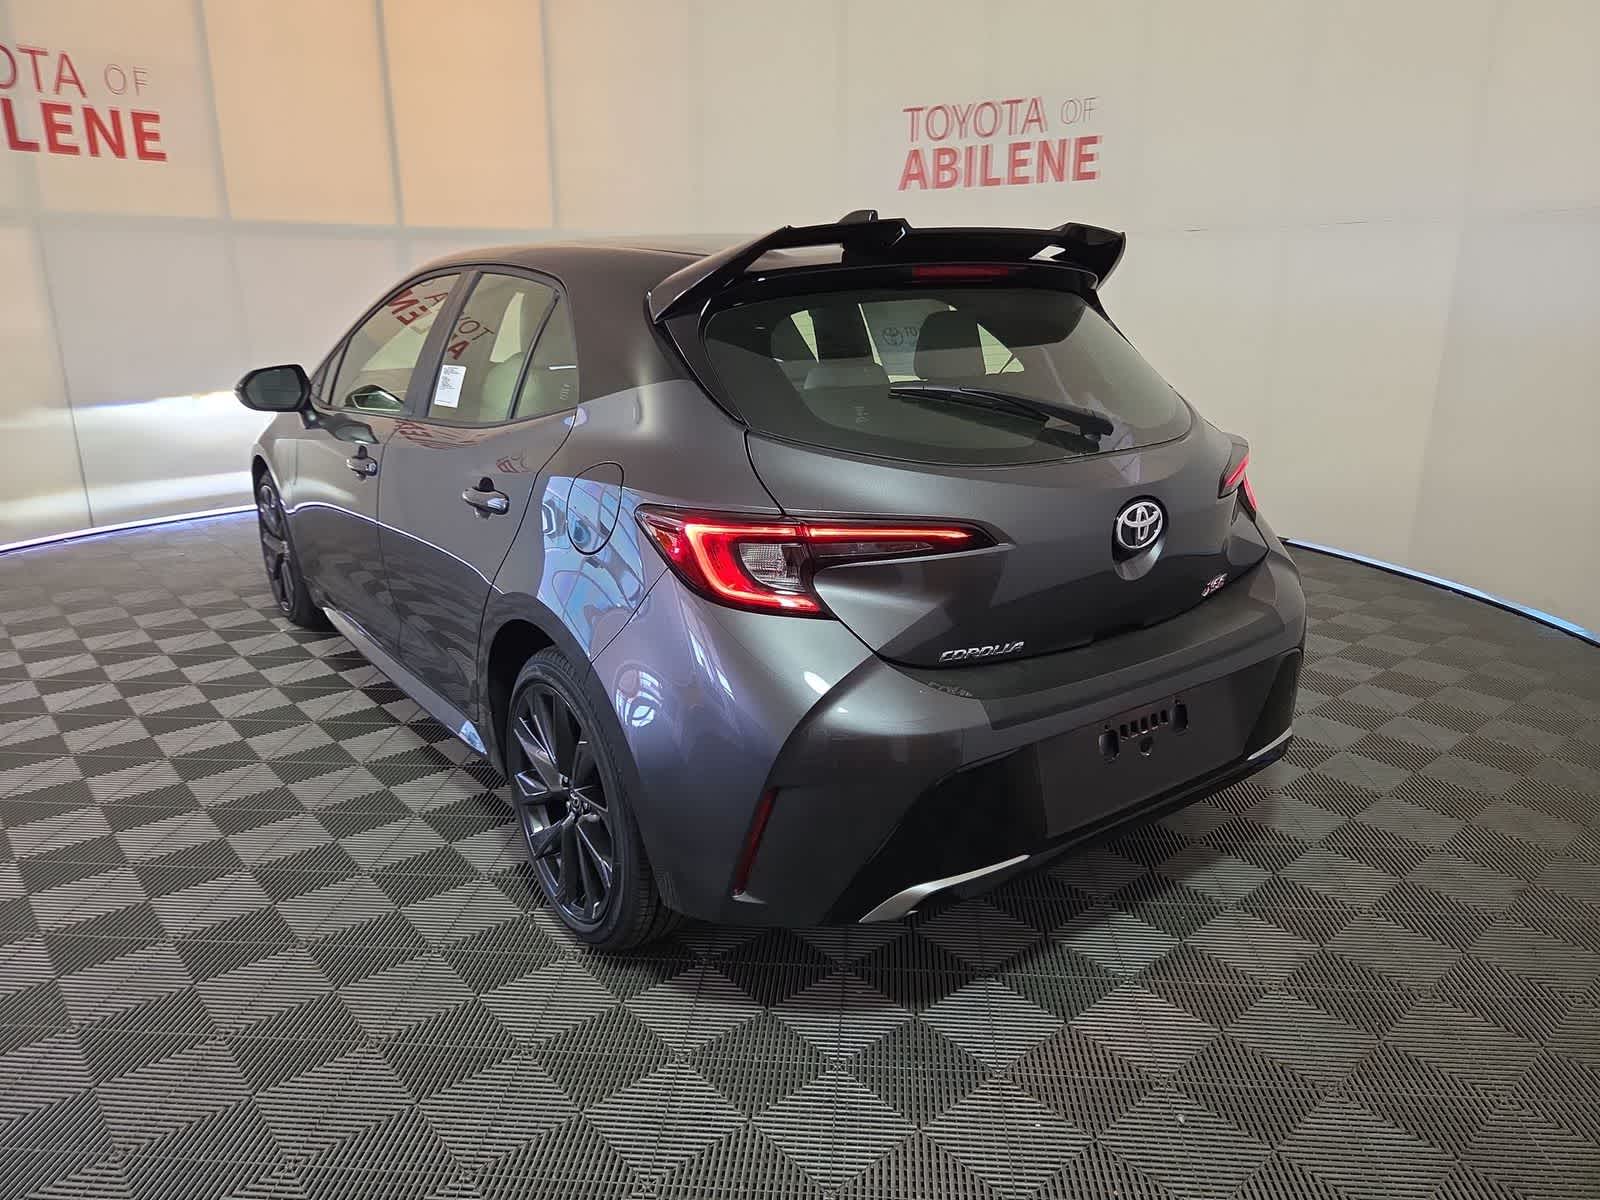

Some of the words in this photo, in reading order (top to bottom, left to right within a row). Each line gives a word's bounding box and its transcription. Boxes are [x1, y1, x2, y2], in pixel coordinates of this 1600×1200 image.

[104, 63, 149, 96] OF
[902, 96, 1048, 143] TOYOTA
[1060, 97, 1097, 125] OF
[898, 135, 1104, 191] ABILENE
[938, 641, 1025, 663] COROLLA
